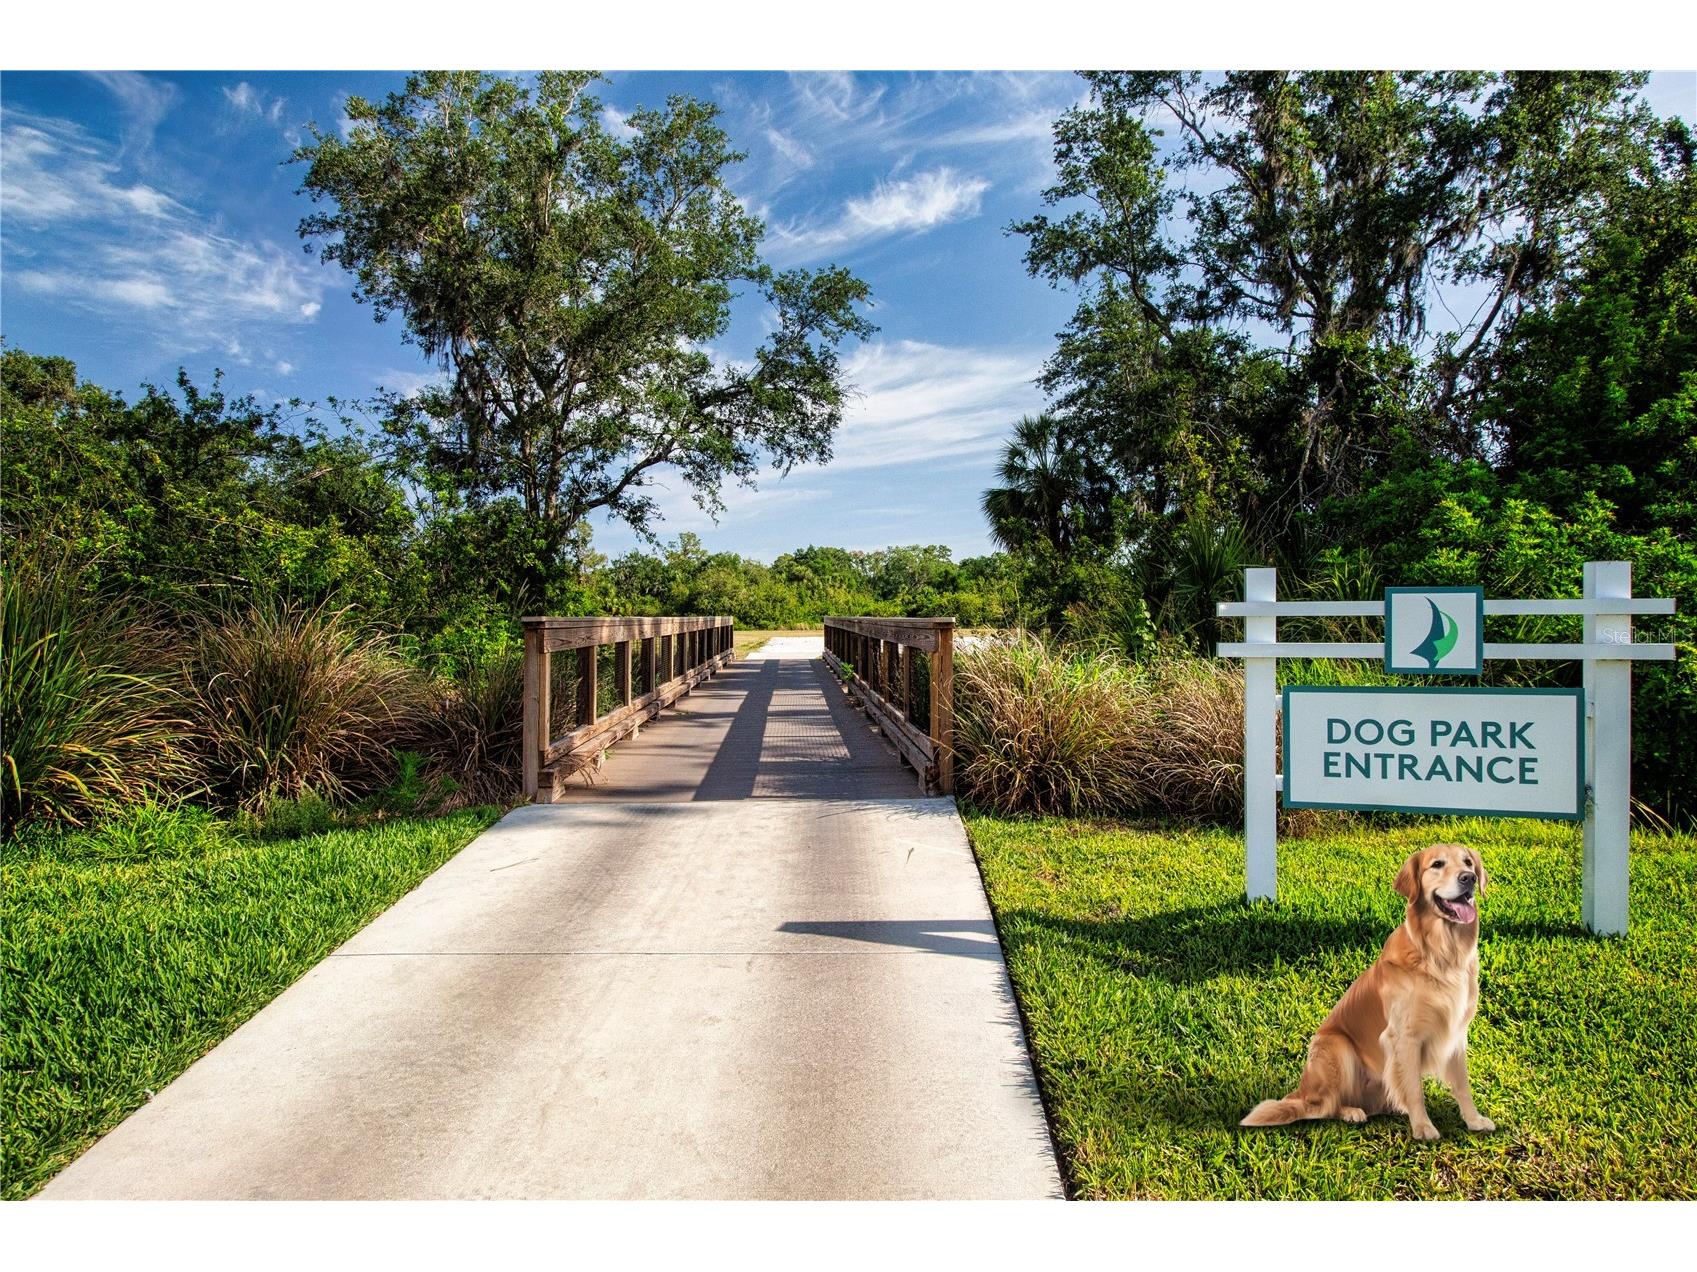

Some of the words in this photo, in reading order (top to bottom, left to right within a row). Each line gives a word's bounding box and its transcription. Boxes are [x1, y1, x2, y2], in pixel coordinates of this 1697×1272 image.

[1327, 718, 1416, 747] DOG
[1431, 720, 1536, 749] PARK
[1323, 751, 1539, 785] ENTRANCE
